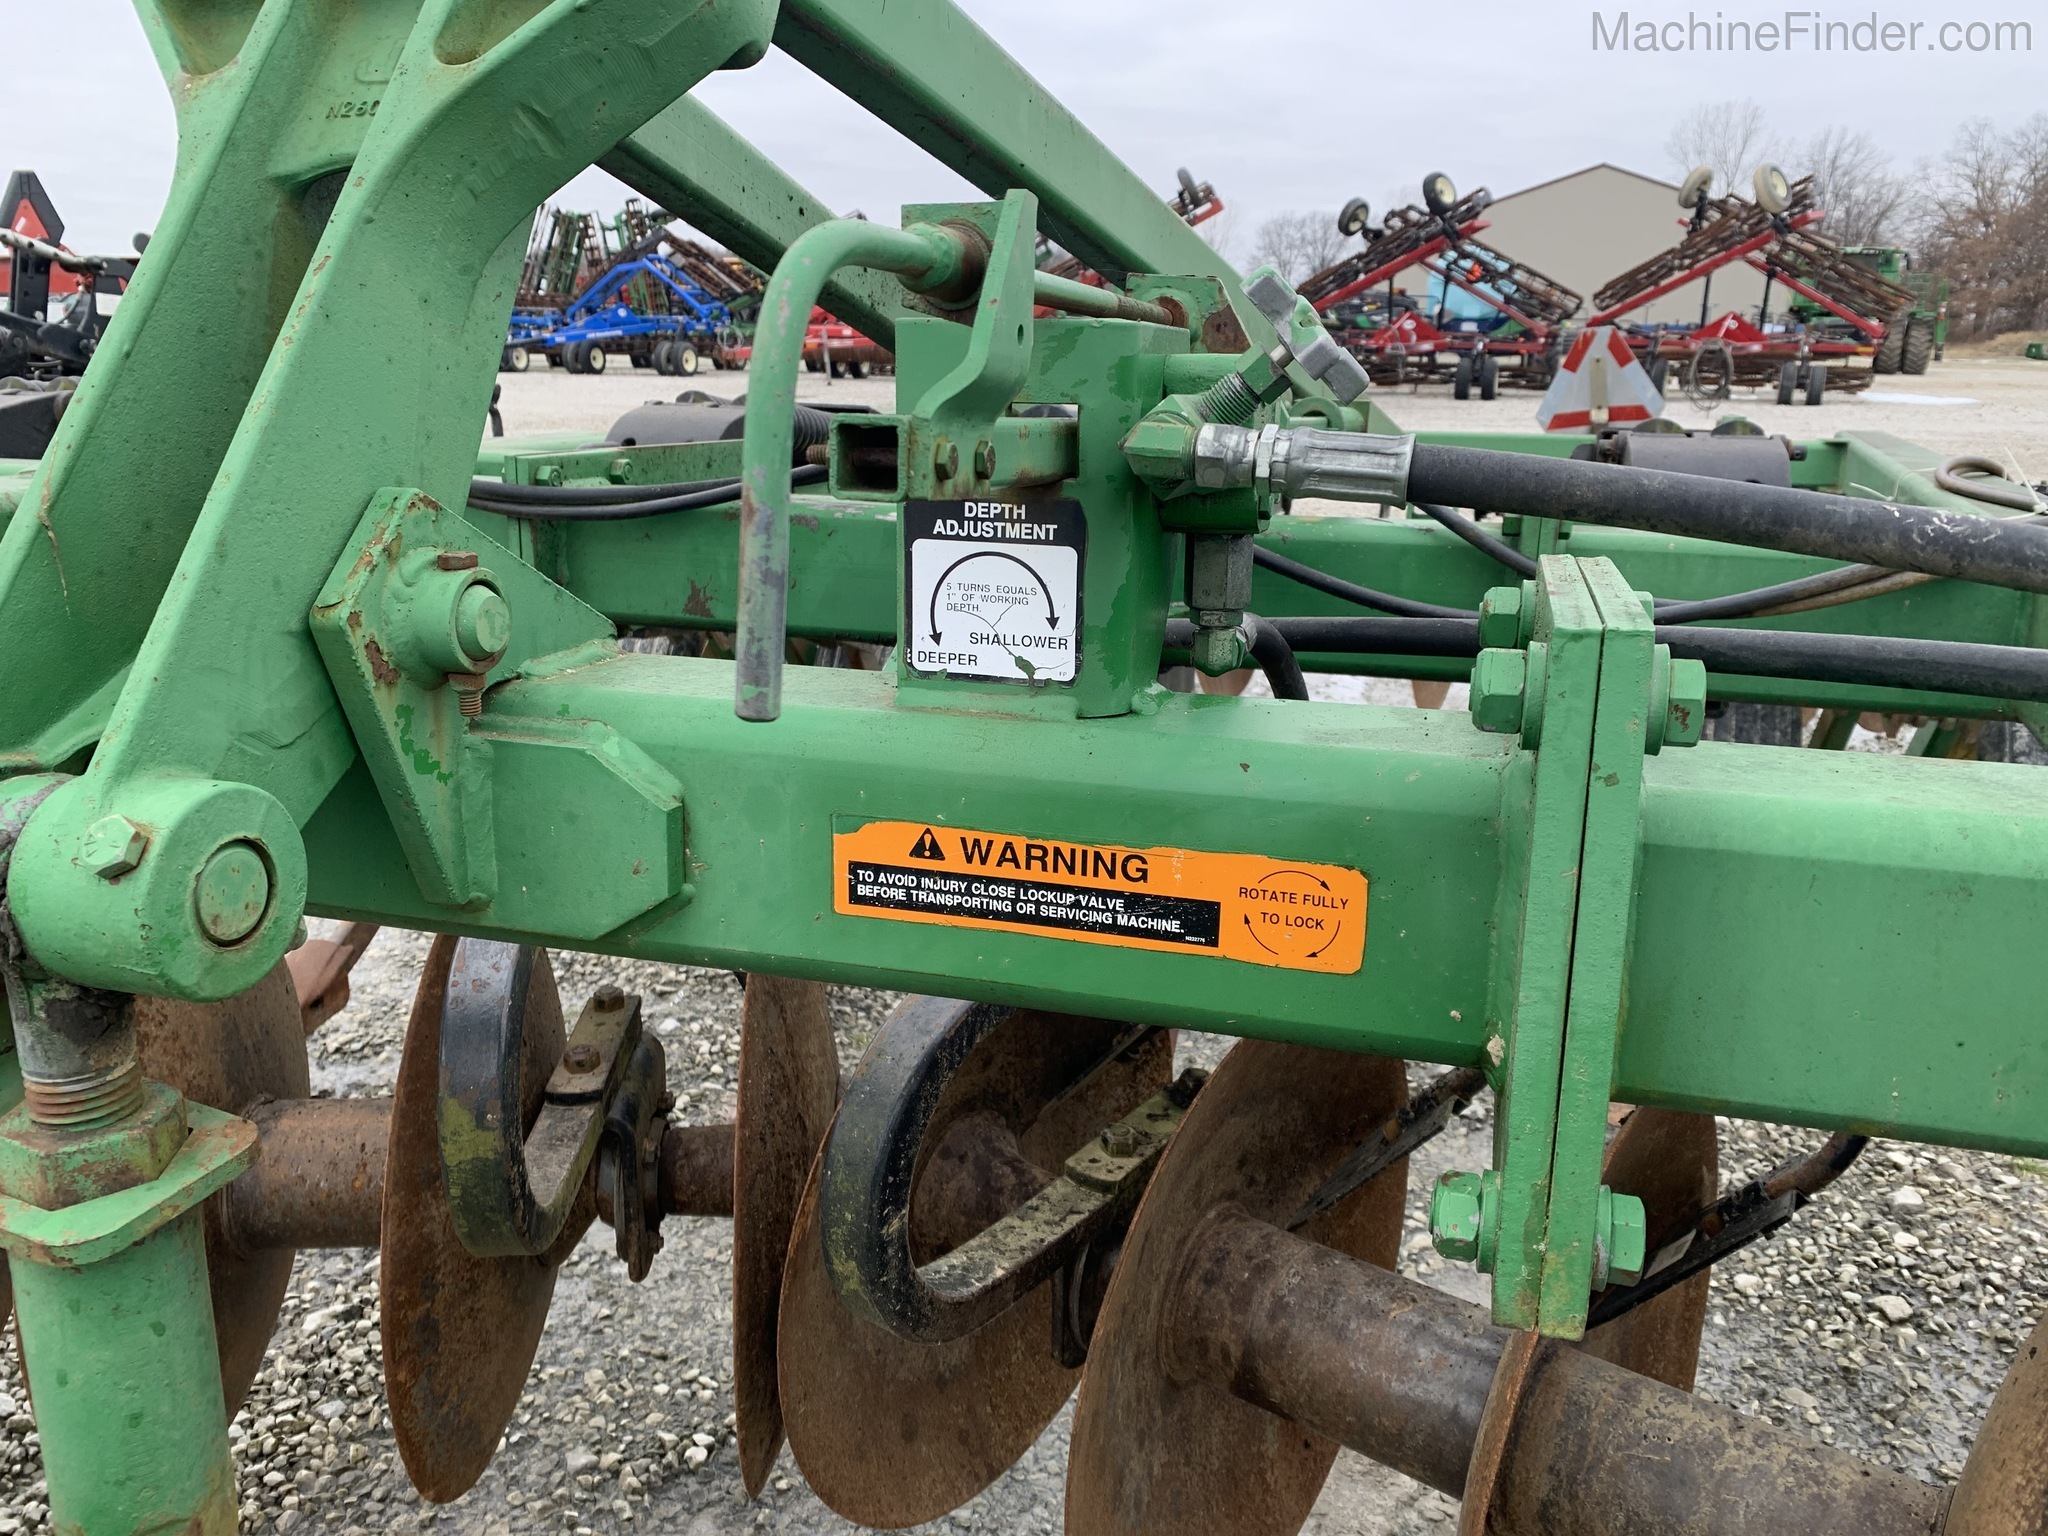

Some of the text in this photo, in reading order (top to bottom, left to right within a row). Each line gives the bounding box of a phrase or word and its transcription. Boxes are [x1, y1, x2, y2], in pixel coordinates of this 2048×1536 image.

[964, 501, 1026, 520] DEPTH
[933, 518, 1058, 541] ADJUSTMENT
[946, 582, 1038, 596] 5 TURNS EQUALS
[946, 603, 982, 613] DEPTH.
[961, 593, 976, 602] OF
[980, 594, 1029, 606] WORKING
[969, 631, 1068, 651] SHALLOWER
[917, 650, 978, 666] DEEPER
[959, 836, 1149, 884] WARNING
[856, 869, 1125, 911] TO AVOID INJURY CLOSE LOCKUP VALVE
[1238, 886, 1349, 911] ROTATE FULLY
[856, 884, 1185, 934] BEFORE TRANSPORTING OR SERVICING MACHINE.
[1260, 911, 1325, 931] TO LOCK
